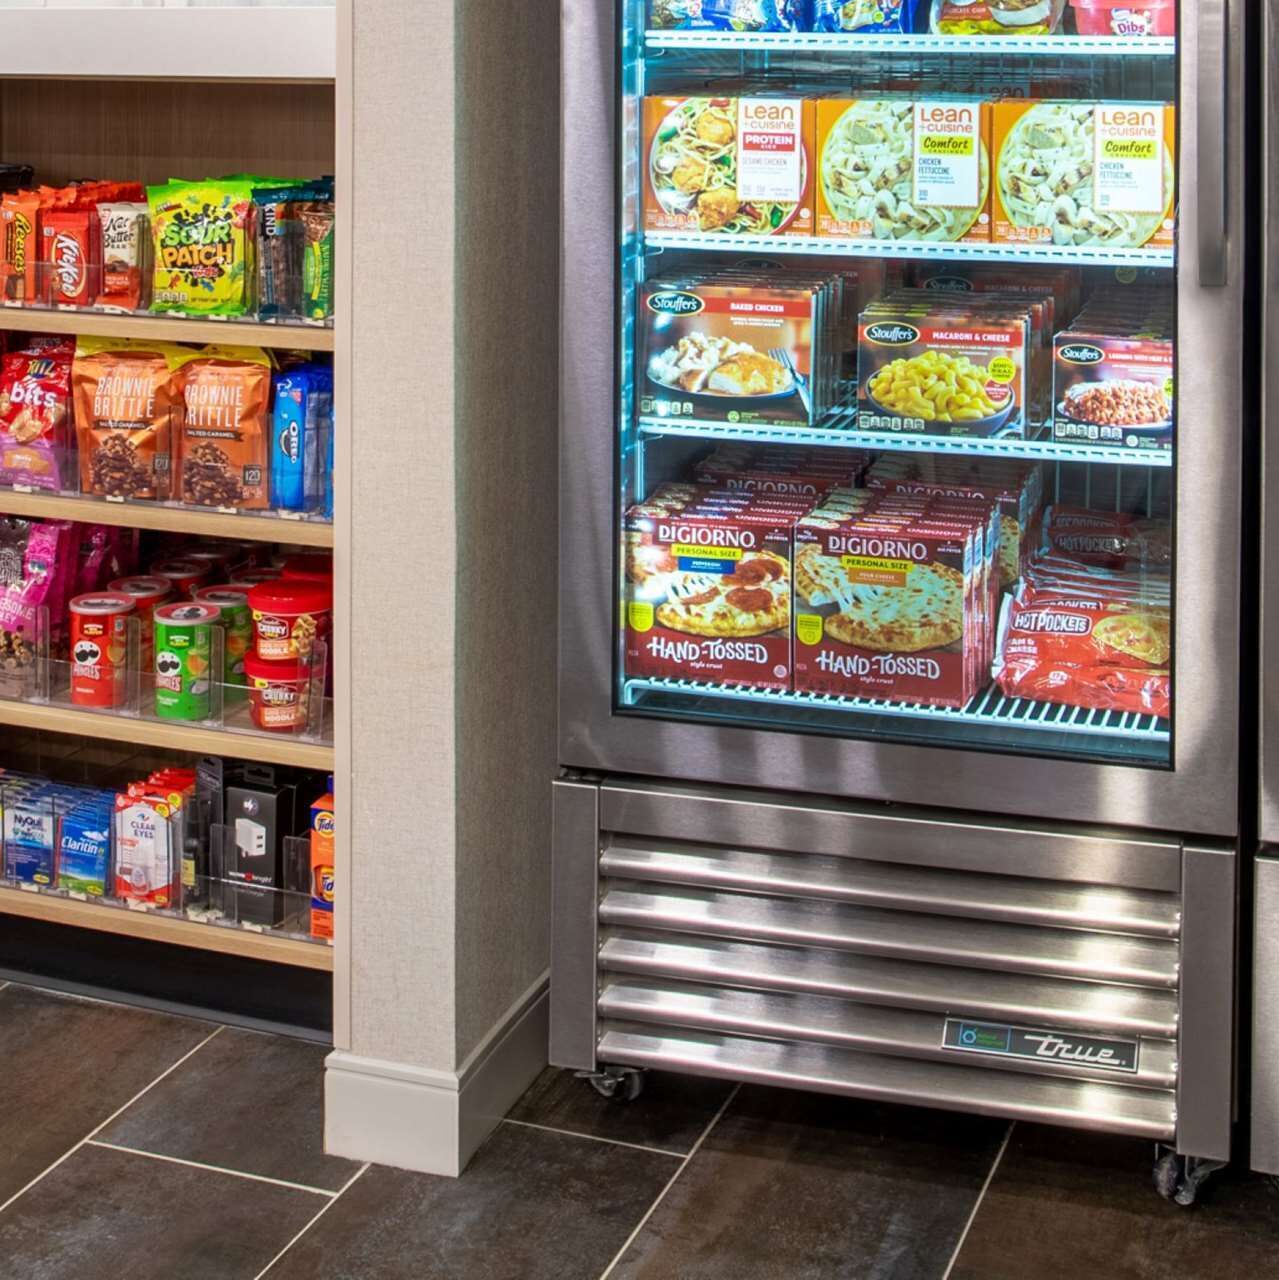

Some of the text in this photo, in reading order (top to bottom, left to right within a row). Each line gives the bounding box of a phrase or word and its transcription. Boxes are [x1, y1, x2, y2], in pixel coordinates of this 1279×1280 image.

[1117, 21, 1145, 34] Dibs
[744, 105, 794, 121] Lean
[920, 107, 973, 122] Lean
[1101, 111, 1156, 125] Lean
[750, 120, 795, 130] cuisine
[926, 122, 973, 134] cuisine
[1106, 126, 1156, 137] cuisine
[744, 135, 793, 145] PROTEIN
[923, 136, 969, 150] Comfort
[1104, 140, 1152, 153] Comfort
[104, 217, 130, 233] Nut
[264, 202, 278, 236] KIND
[164, 221, 231, 247] SOUR
[162, 241, 233, 267] PATCH
[652, 296, 699, 312] Stouffer's
[730, 302, 784, 312] BAKED CHICKEN
[868, 325, 914, 342] Stouffer's
[932, 331, 1011, 343] MACARONI & CHEESE
[1062, 347, 1100, 360] Stouffer's
[10, 381, 57, 407] bits
[96, 376, 156, 398] BROWNIE
[94, 396, 155, 418] BRITTLE
[185, 406, 242, 428] RITTLE
[675, 546, 738, 558] PERSONAL SIZE
[846, 558, 909, 570] PERSONAL SIZE
[1014, 613, 1087, 632] HOT POCKETS
[646, 636, 769, 664] HAND-TOSSED
[815, 650, 941, 680] HAND-TOSSED
[61, 835, 99, 856] Claritin
